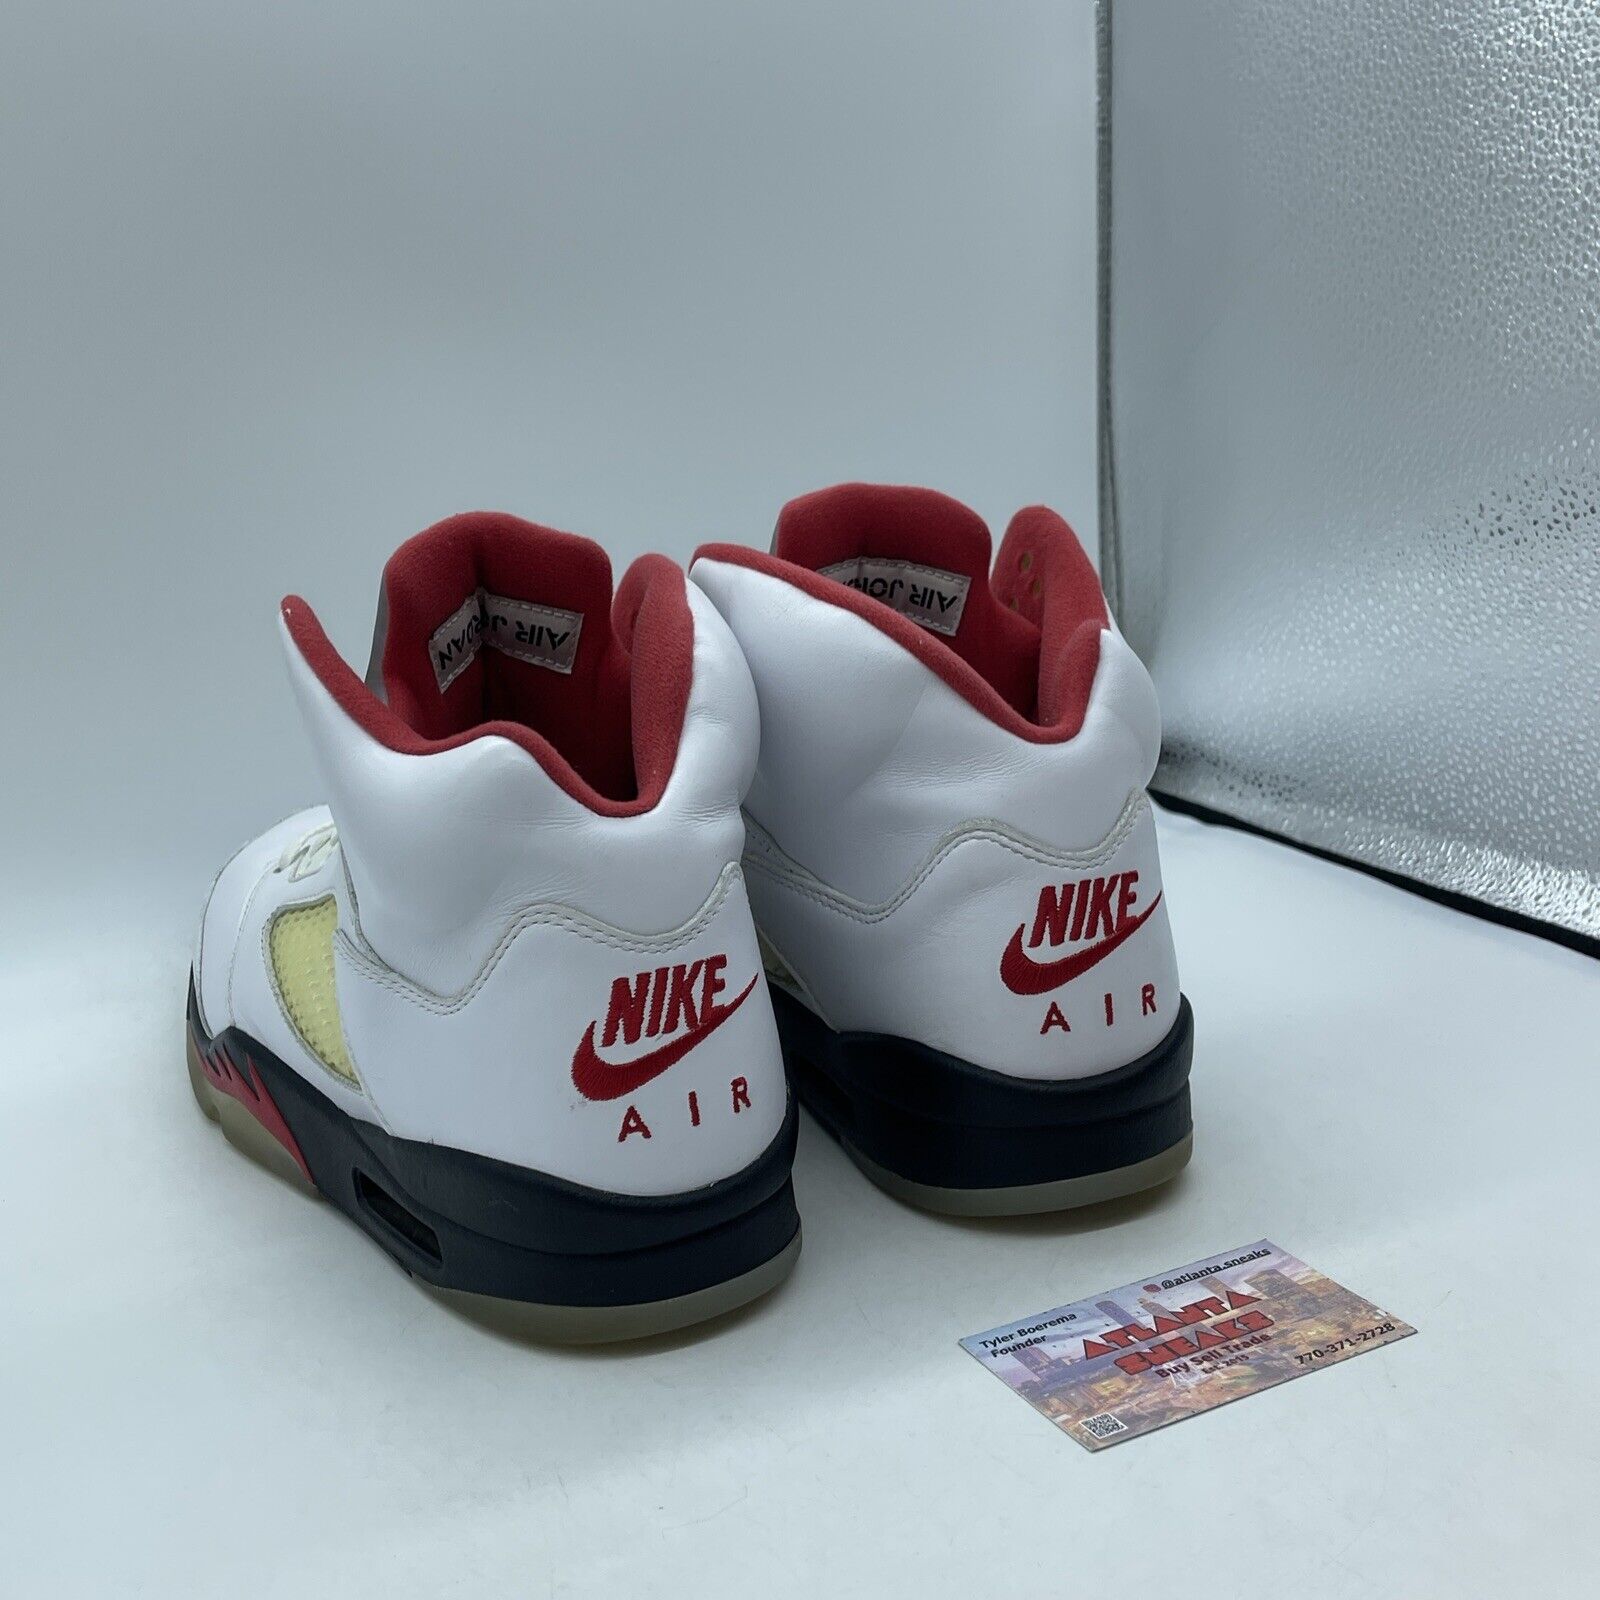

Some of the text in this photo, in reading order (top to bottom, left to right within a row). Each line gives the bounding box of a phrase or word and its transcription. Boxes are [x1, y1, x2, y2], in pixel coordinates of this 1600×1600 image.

[909, 584, 958, 613] AIR
[438, 604, 570, 670] AIR JRDAN
[1027, 870, 1139, 948] NIKE
[600, 954, 728, 1048] NIKE
[1040, 983, 1157, 1035] AIR
[617, 1077, 751, 1143] AIR
[1161, 1247, 1272, 1290] @atlanta.sneaks
[979, 1312, 1078, 1350] Tyler Boerema
[990, 1334, 1048, 1358] Founder
[1083, 1290, 1262, 1360] ATLANTA
[1113, 1310, 1275, 1376] SNEAKS
[1294, 1322, 1396, 1365] 770-371-2728
[1154, 1334, 1272, 1379] Buy Sell Trade
